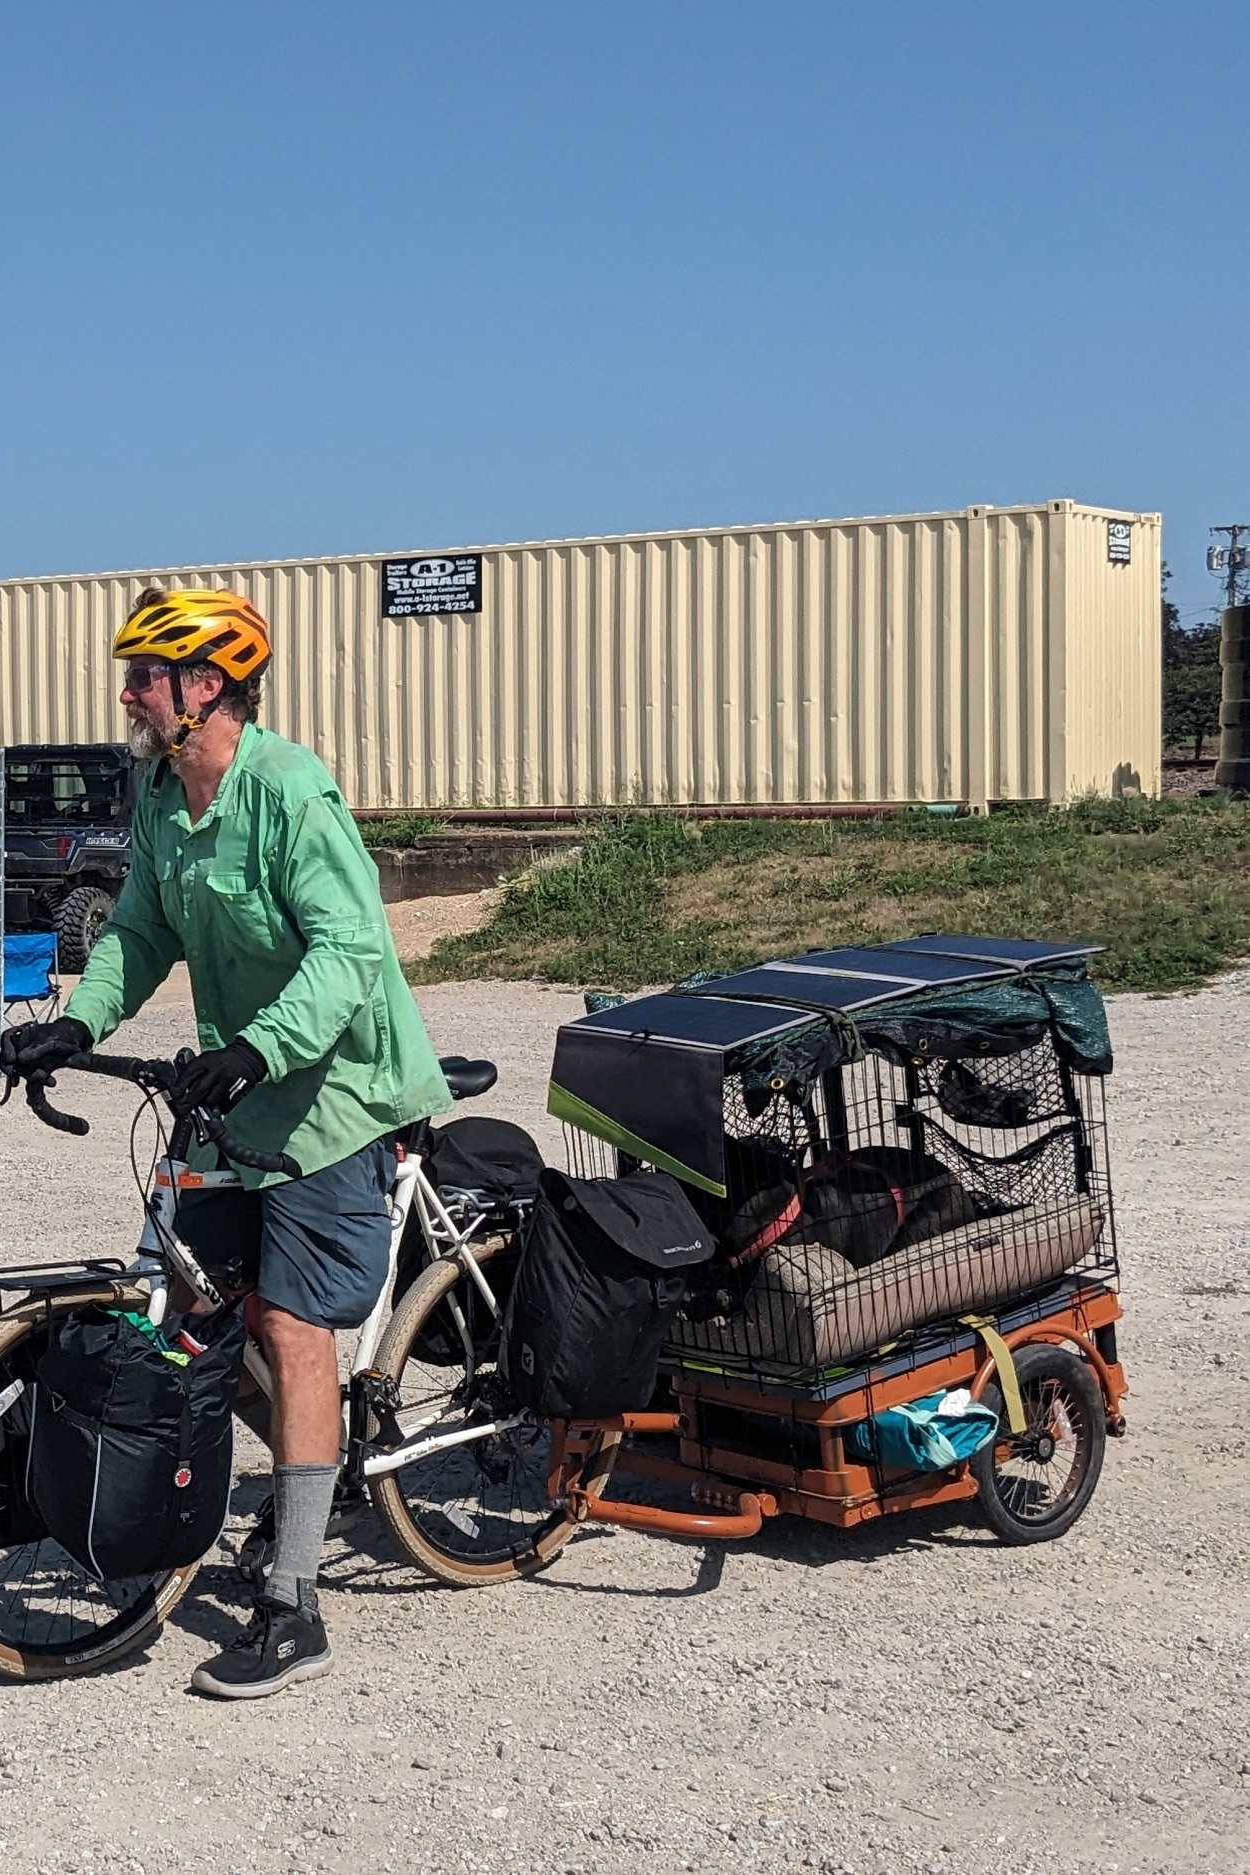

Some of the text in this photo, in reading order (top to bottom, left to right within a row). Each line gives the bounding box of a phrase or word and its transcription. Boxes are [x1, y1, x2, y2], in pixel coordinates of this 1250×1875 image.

[418, 563, 447, 574] A-1
[387, 571, 477, 591] STORAGE
[393, 591, 470, 604] www.a-1storage.net
[388, 600, 476, 615] 800-924-4254
